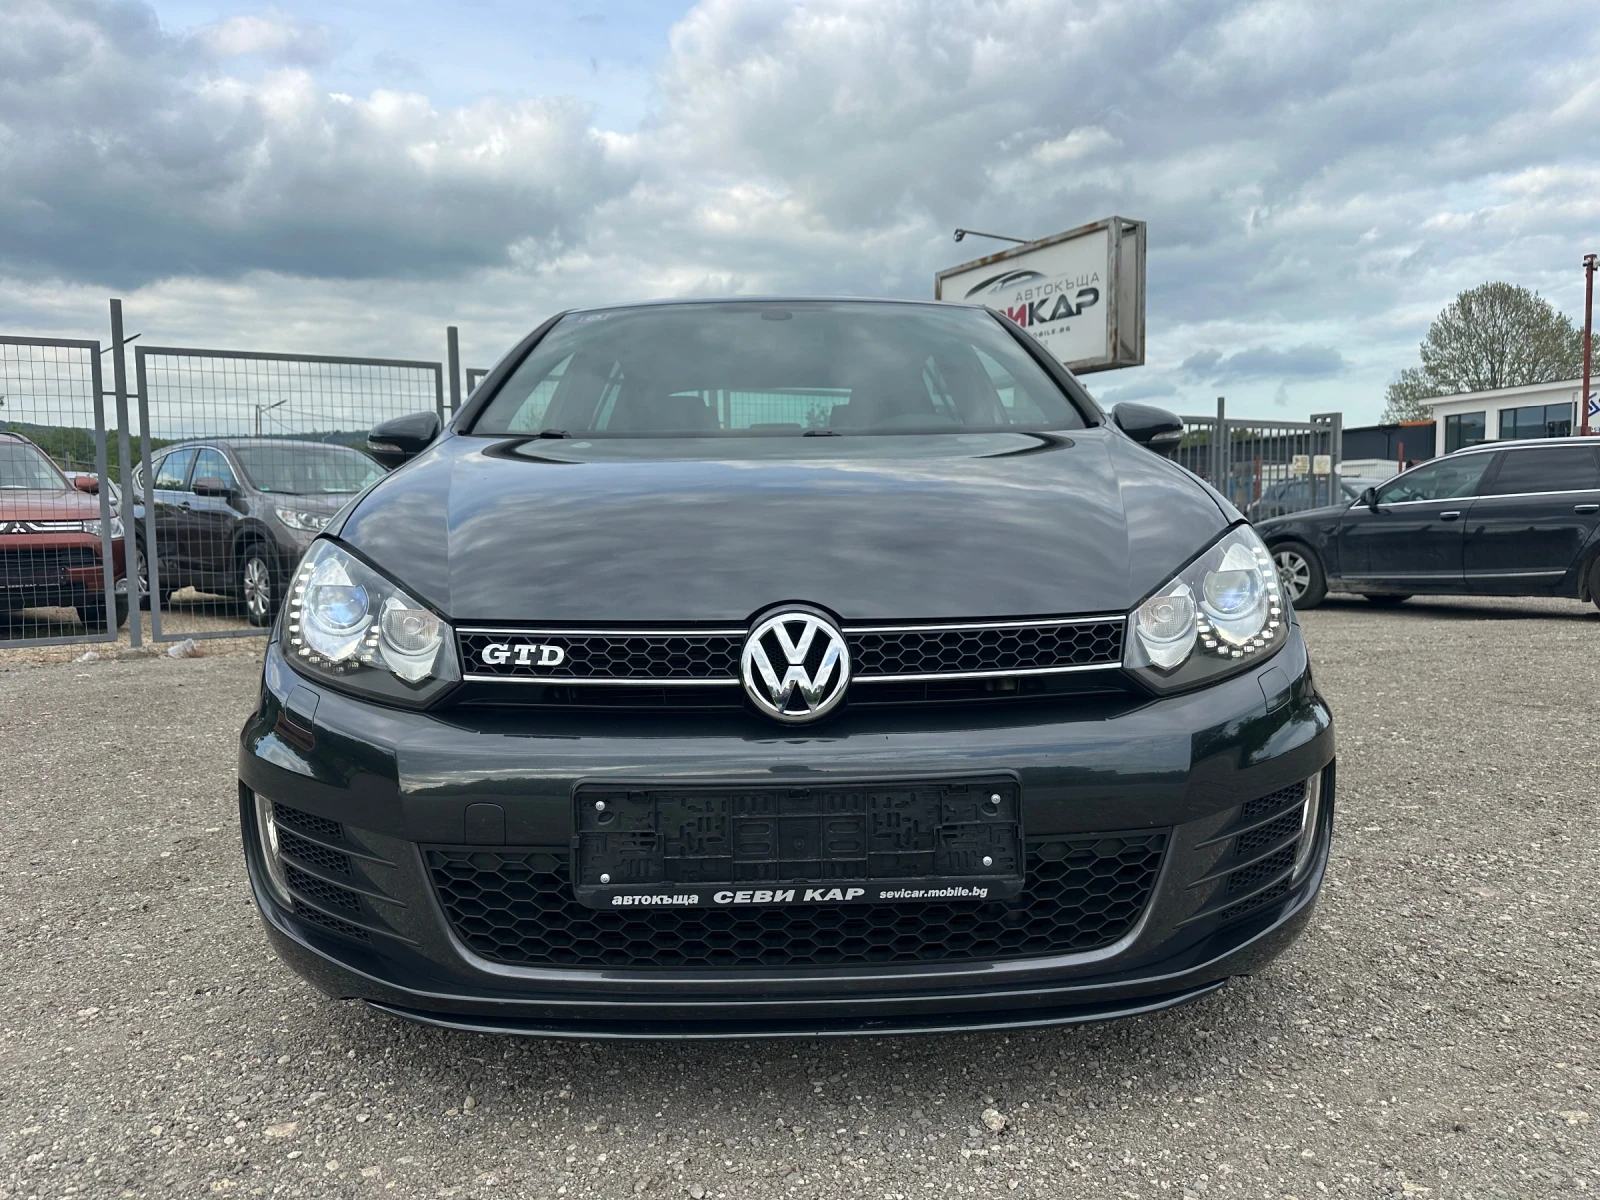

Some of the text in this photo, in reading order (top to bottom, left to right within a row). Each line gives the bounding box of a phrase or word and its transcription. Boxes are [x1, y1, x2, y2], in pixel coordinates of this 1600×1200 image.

[1015, 272, 1099, 303] АВТОКЪЩА
[998, 287, 1099, 328] ИКАР
[481, 643, 565, 667] GTD
[612, 886, 988, 906] автокъща СЕВИ КАР sevicar.mobile.bg
